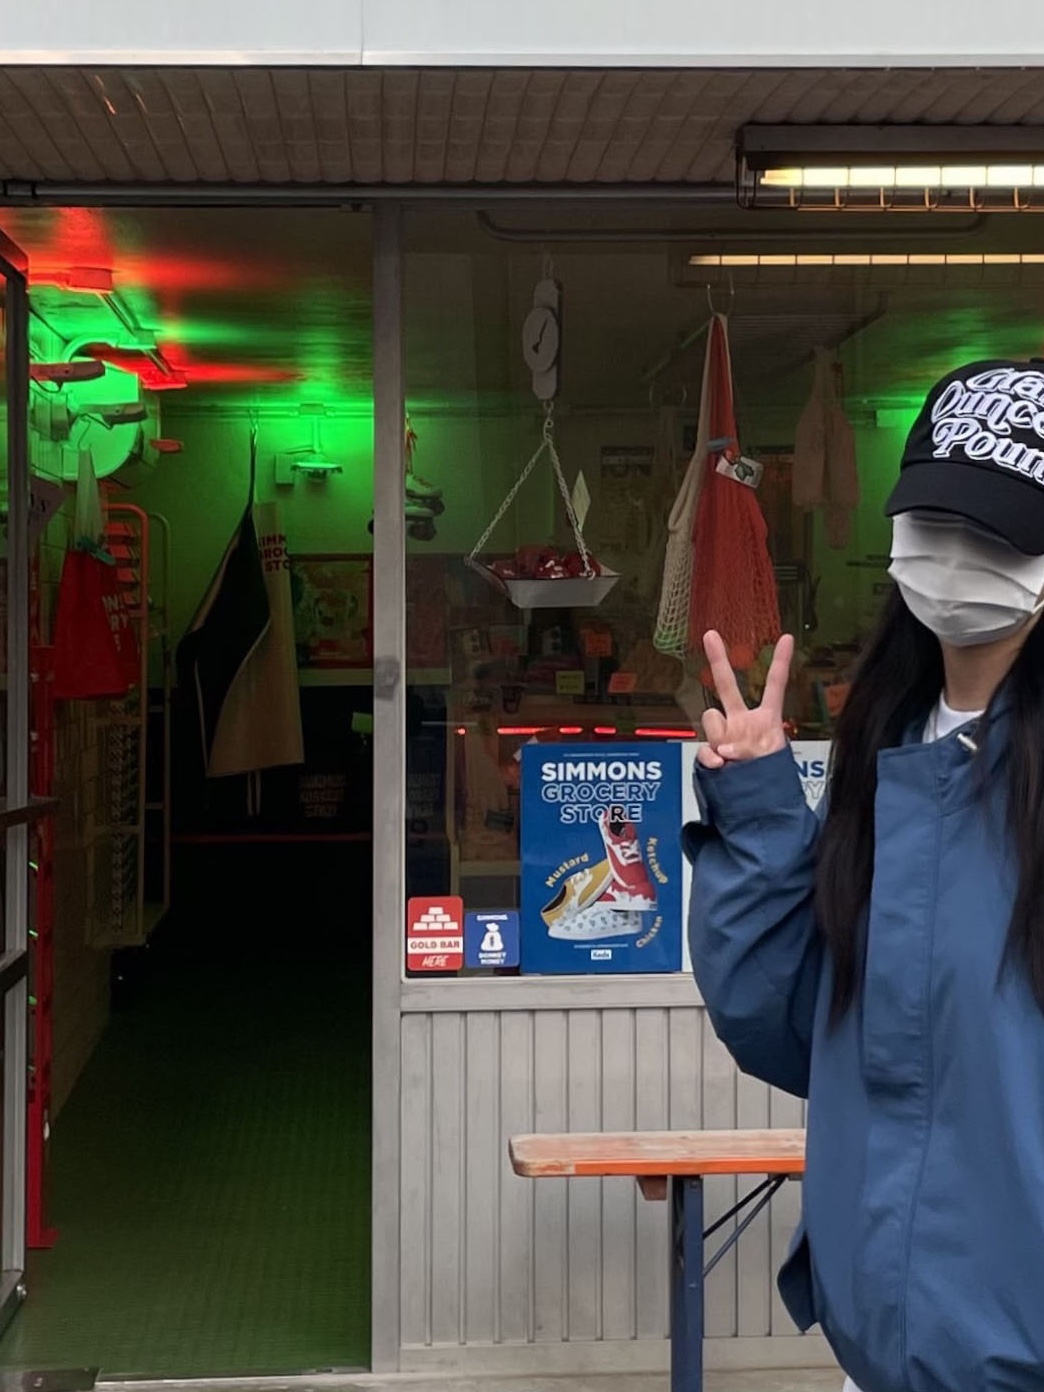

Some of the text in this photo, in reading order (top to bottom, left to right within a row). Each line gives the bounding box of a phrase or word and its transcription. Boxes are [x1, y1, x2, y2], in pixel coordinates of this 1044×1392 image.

[541, 761, 663, 782] SIMMONS
[541, 782, 661, 803] GROCERY
[560, 803, 643, 824] STORE
[545, 853, 590, 887] Mustard
[646, 837, 669, 884] Ketchup
[410, 940, 460, 950] GOLD BAR
[421, 955, 450, 967] HERE
